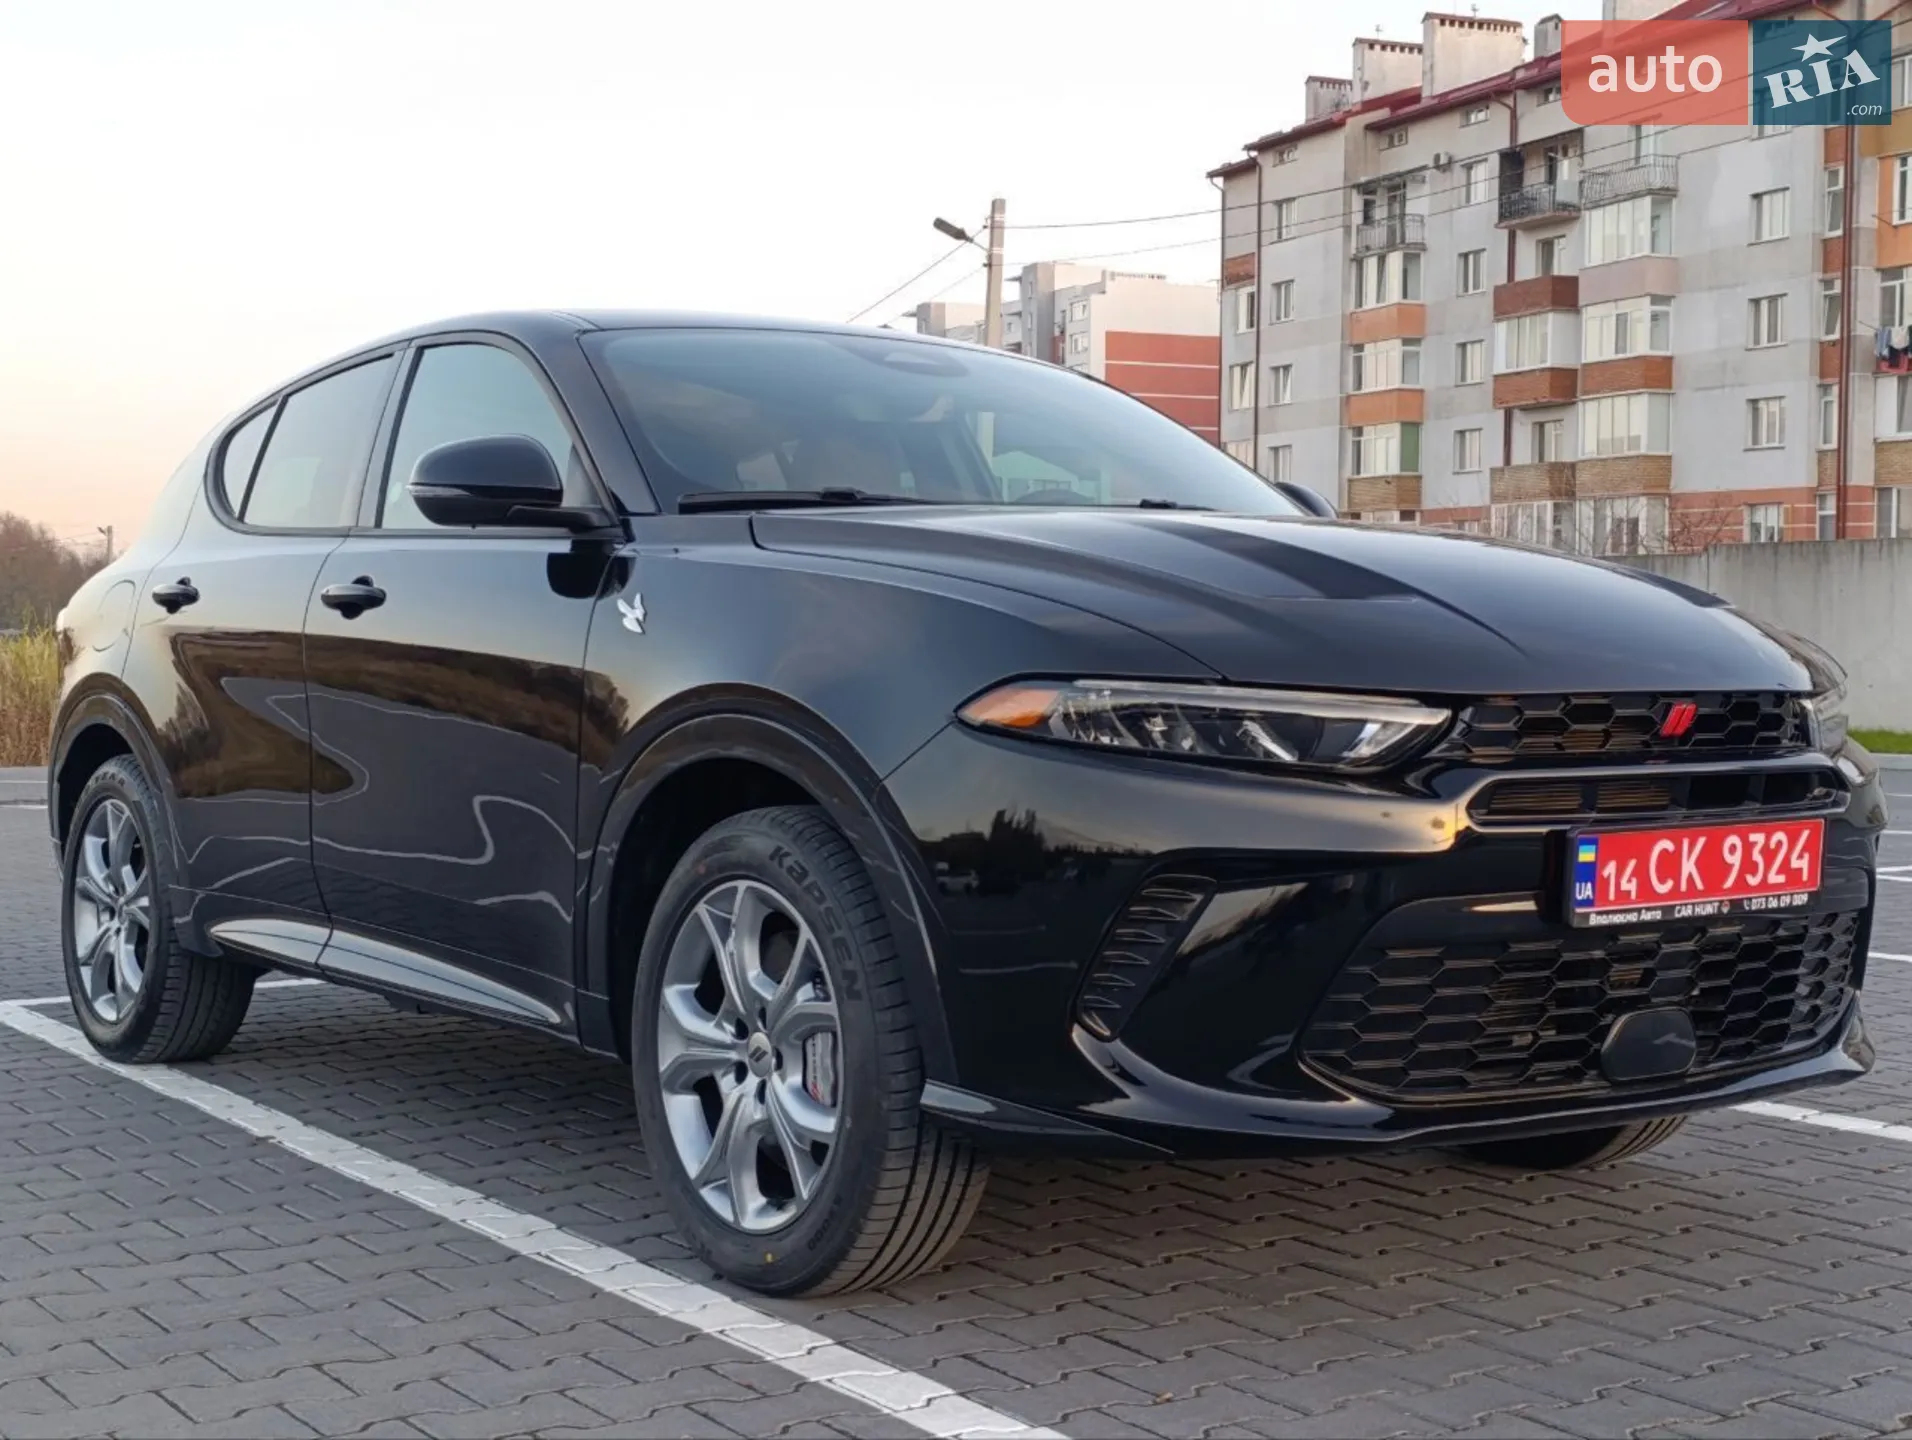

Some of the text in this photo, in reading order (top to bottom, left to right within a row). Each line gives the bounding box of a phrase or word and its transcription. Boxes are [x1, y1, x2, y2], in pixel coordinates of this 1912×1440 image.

[1601, 829, 1811, 901] 14 CK 9324
[1575, 882, 1594, 900] UA
[1674, 902, 1720, 918] CAR HUNT
